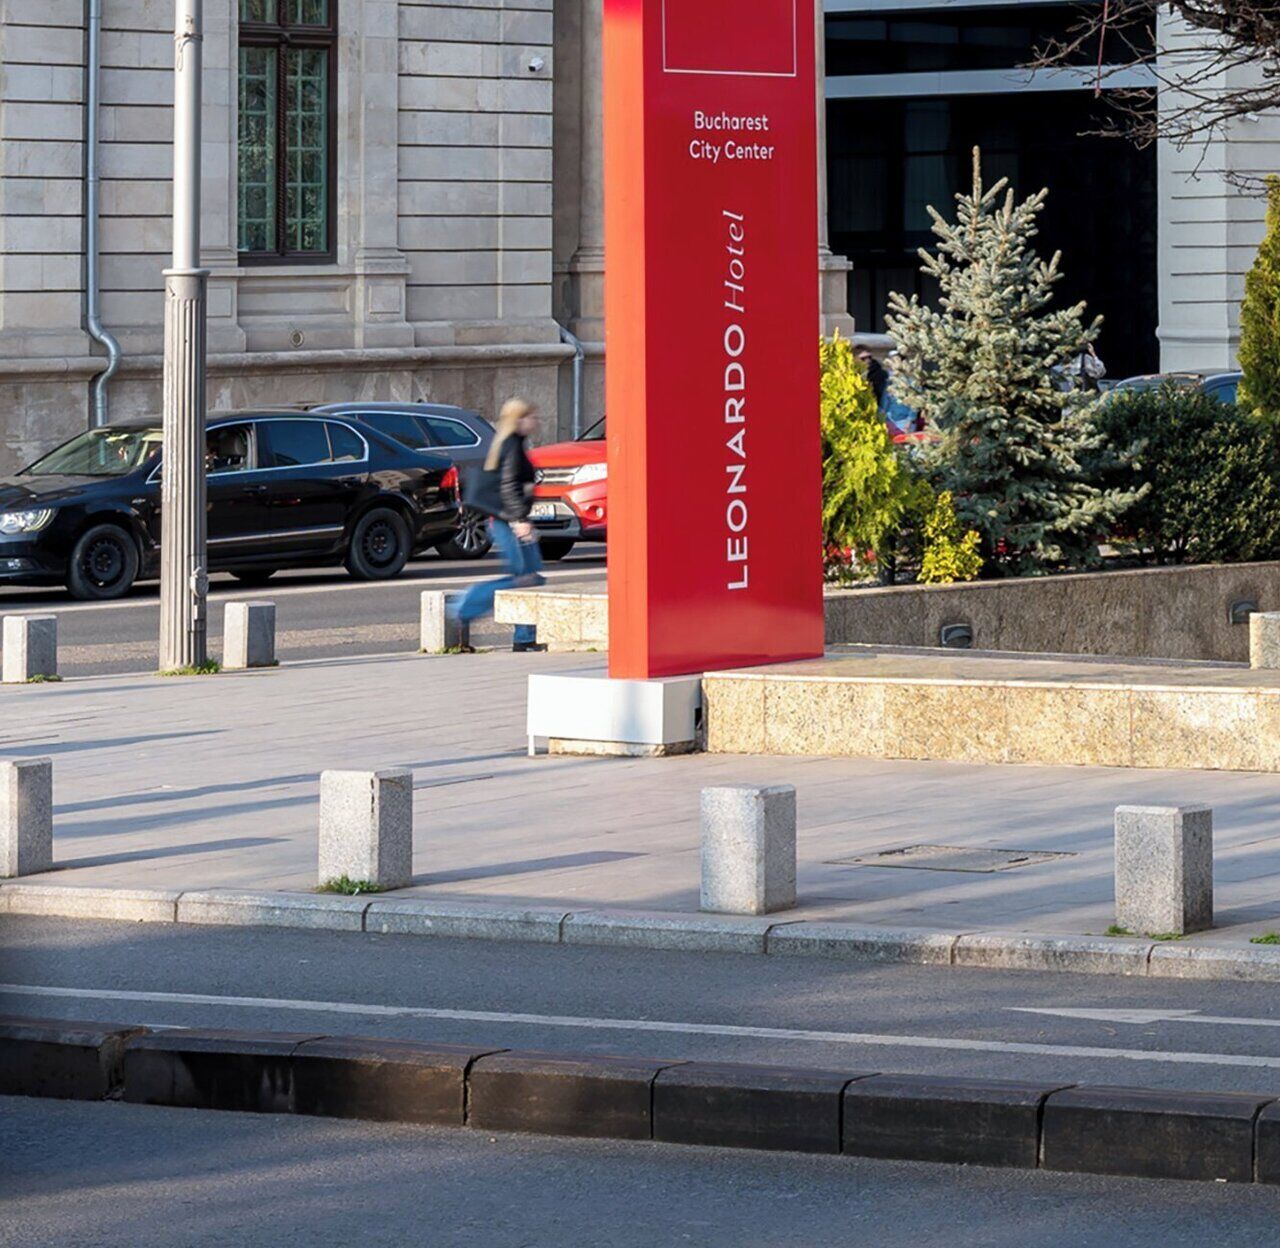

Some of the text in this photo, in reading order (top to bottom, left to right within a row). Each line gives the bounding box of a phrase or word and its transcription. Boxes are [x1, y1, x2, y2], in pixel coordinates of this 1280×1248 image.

[694, 110, 769, 131] Bucharest
[689, 139, 775, 164] City Center
[722, 209, 749, 591] LEONARDO Hotel
